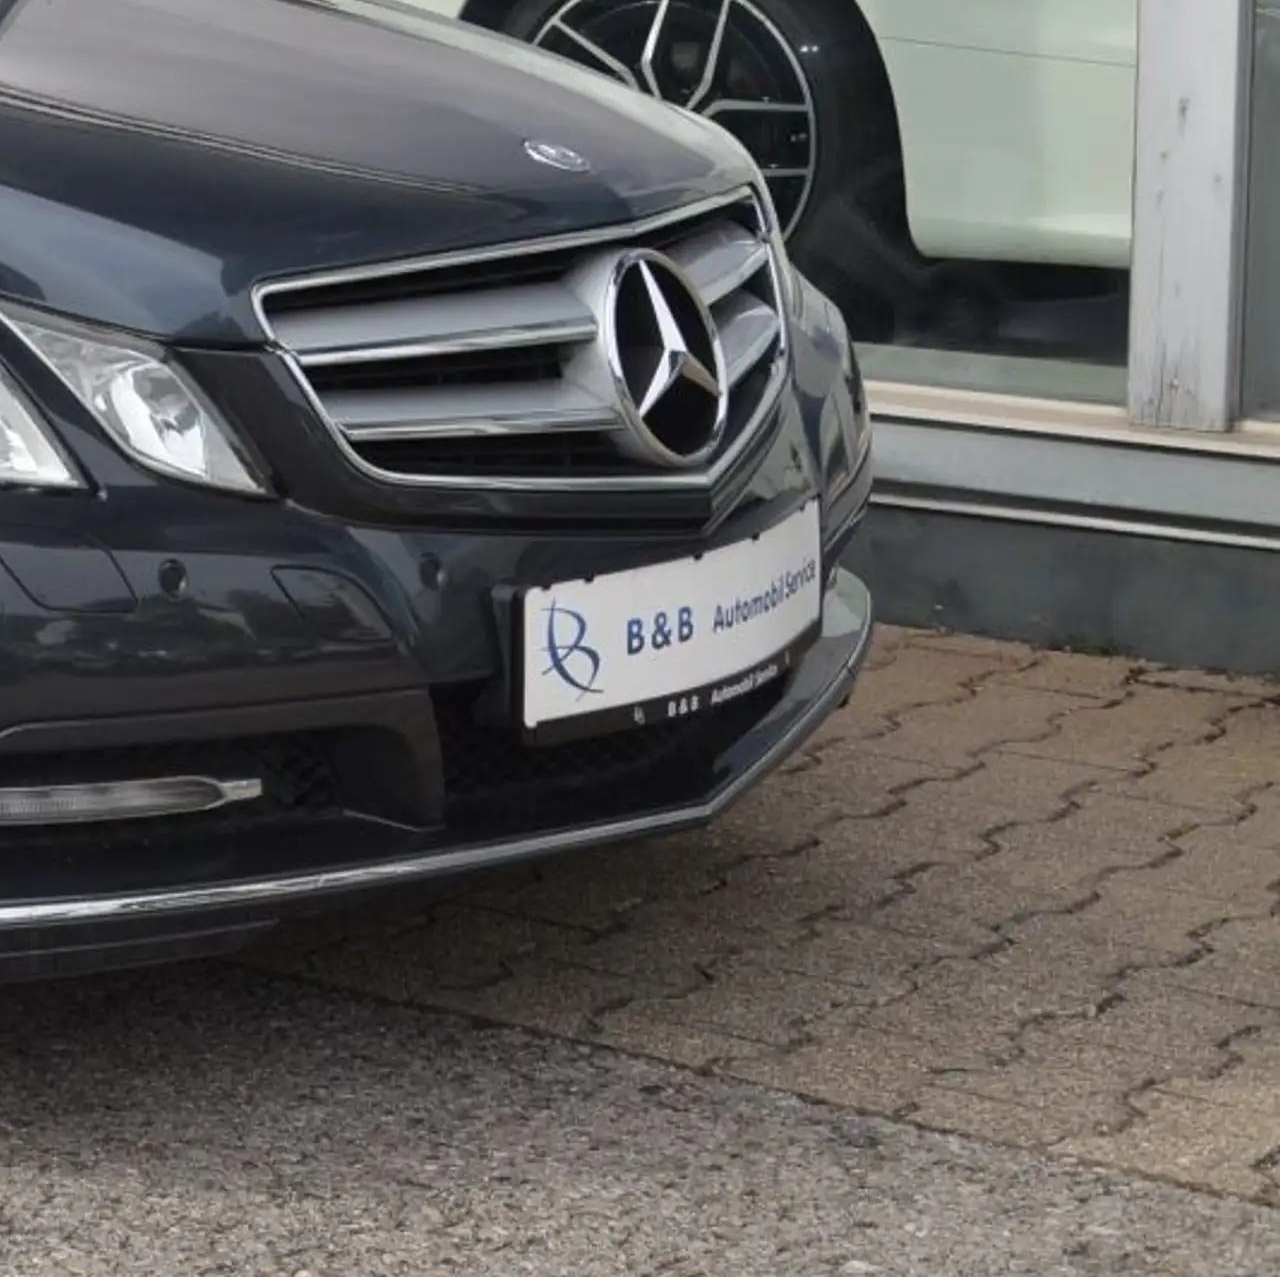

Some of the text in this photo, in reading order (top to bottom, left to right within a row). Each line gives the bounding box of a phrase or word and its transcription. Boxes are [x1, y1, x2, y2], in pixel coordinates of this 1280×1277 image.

[626, 618, 644, 656] B
[651, 611, 672, 650] &
[678, 605, 694, 643] B
[713, 574, 784, 633] Automobil
